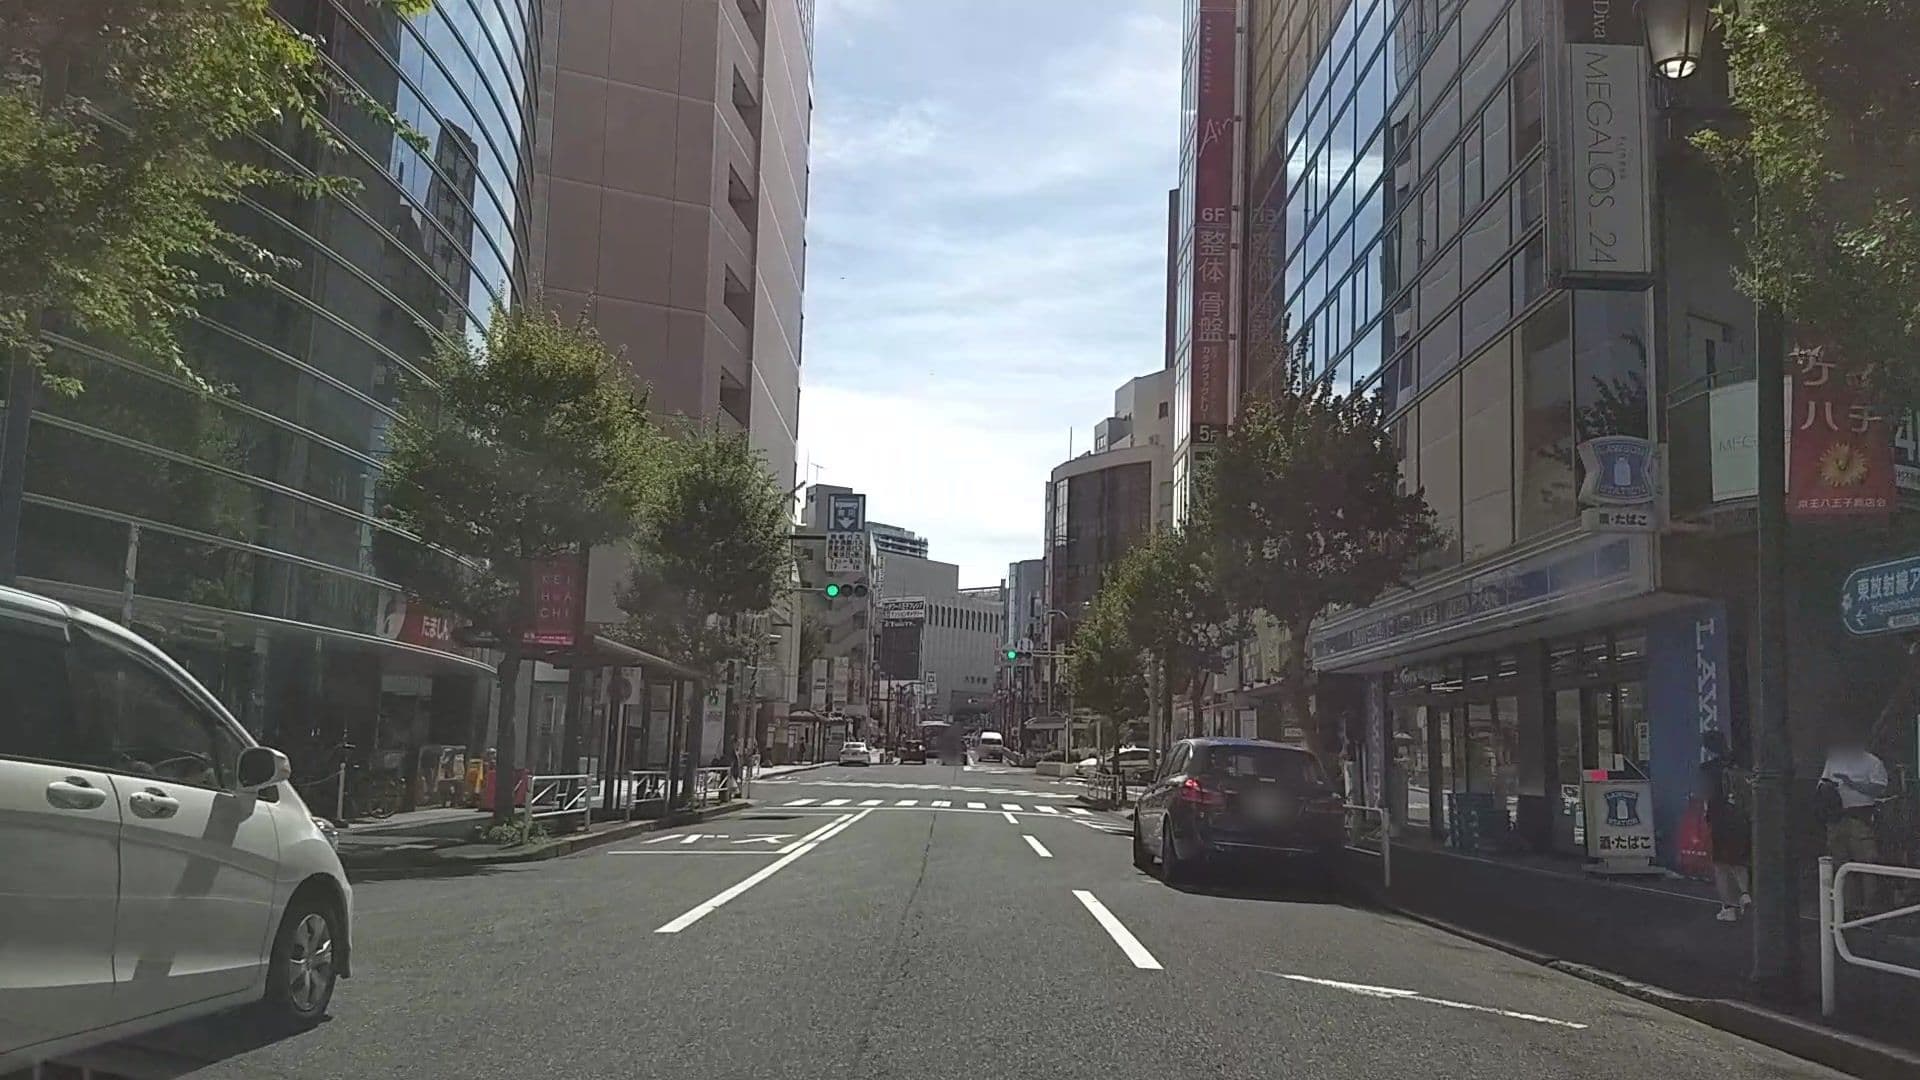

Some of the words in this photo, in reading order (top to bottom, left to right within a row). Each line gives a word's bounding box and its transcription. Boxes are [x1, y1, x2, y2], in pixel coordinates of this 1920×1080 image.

[1593, 0, 1609, 38] Diva
[1201, 207, 1225, 221] 6F
[1198, 229, 1226, 284] 整体
[1197, 292, 1225, 342] 骨盤
[640, 833, 797, 845] バス
